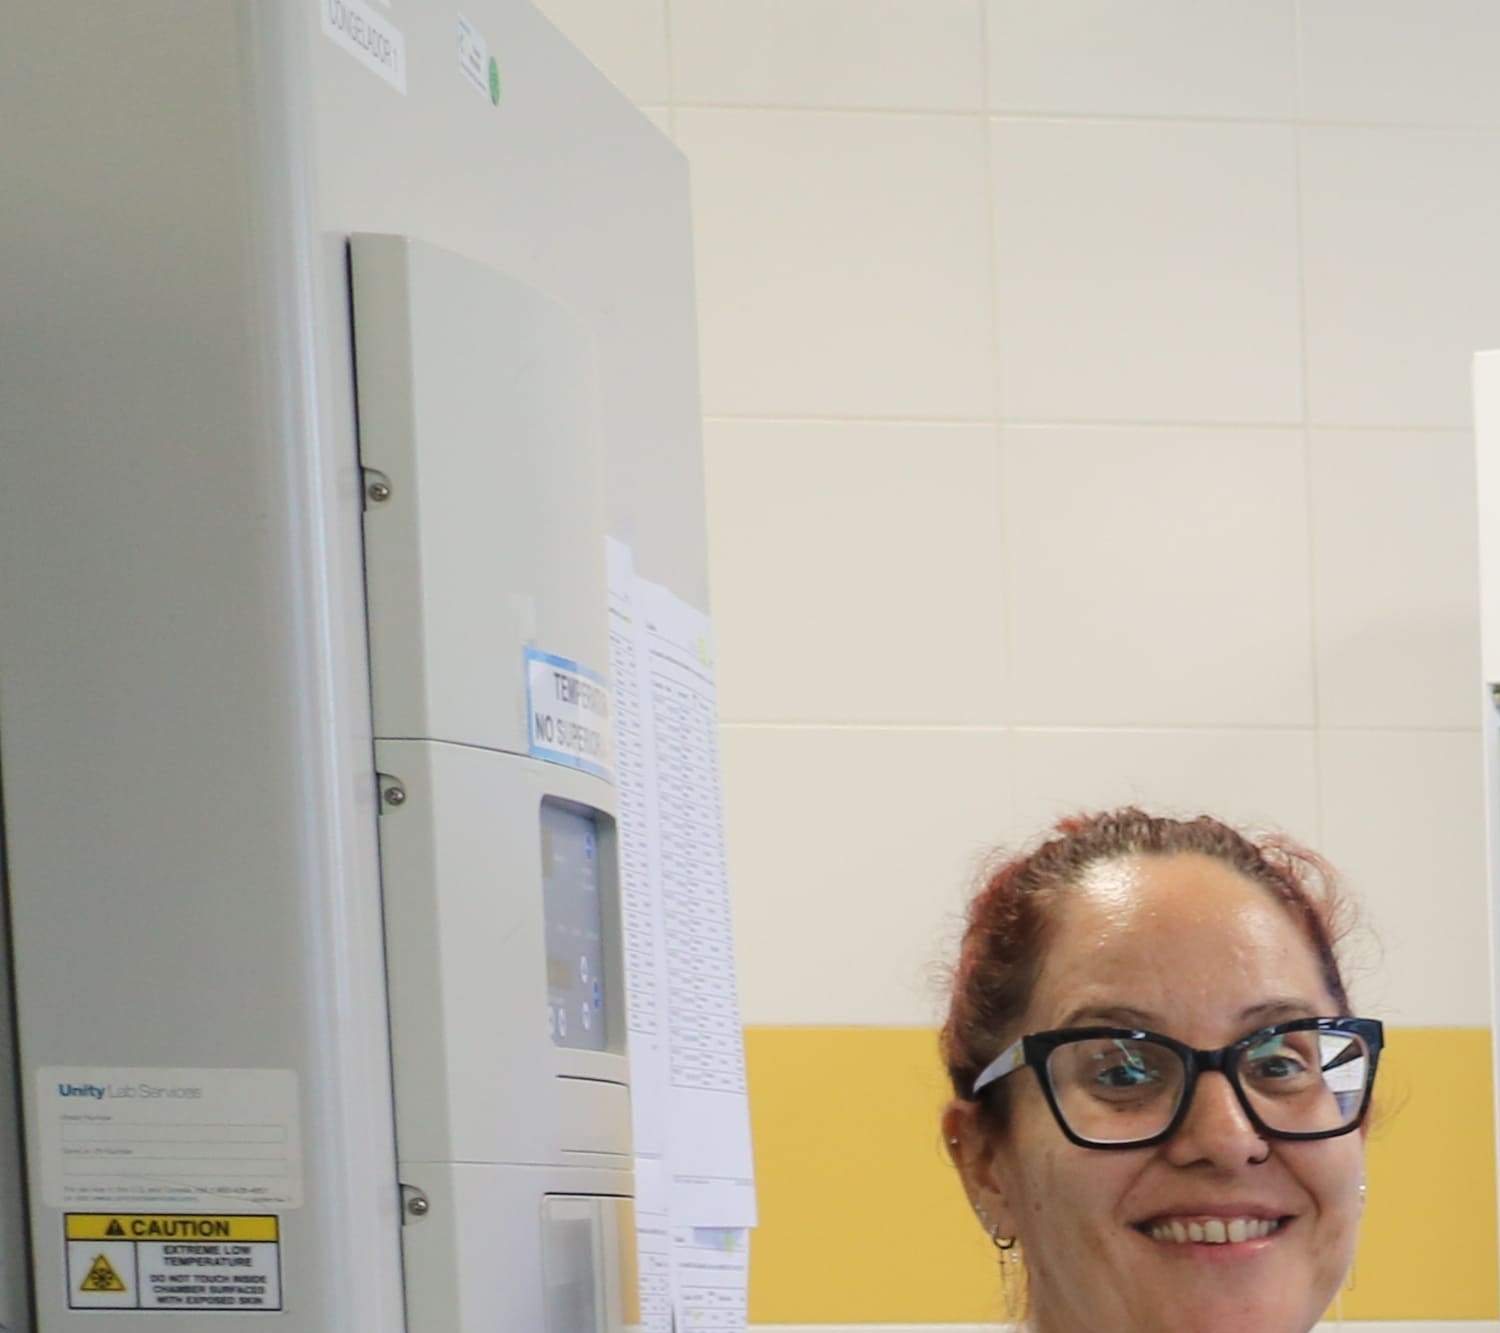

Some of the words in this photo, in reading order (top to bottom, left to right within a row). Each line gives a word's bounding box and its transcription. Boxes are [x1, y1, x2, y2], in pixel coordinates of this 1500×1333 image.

[58, 1083, 106, 1100] Unity
[108, 1083, 136, 1098] Lab
[138, 1083, 203, 1099] Services
[131, 1219, 230, 1237] CAUTION
[163, 1245, 220, 1255] EXTREME
[225, 1245, 252, 1255] LOW
[164, 1256, 253, 1267] TEMPERATURE
[150, 1274, 166, 1284] DO
[169, 1274, 189, 1284] NOT
[193, 1274, 230, 1284] TOUCH
[152, 1285, 206, 1295] CHAMBER
[209, 1285, 267, 1295] SURFACES
[186, 1296, 236, 1305] EXPOSED
